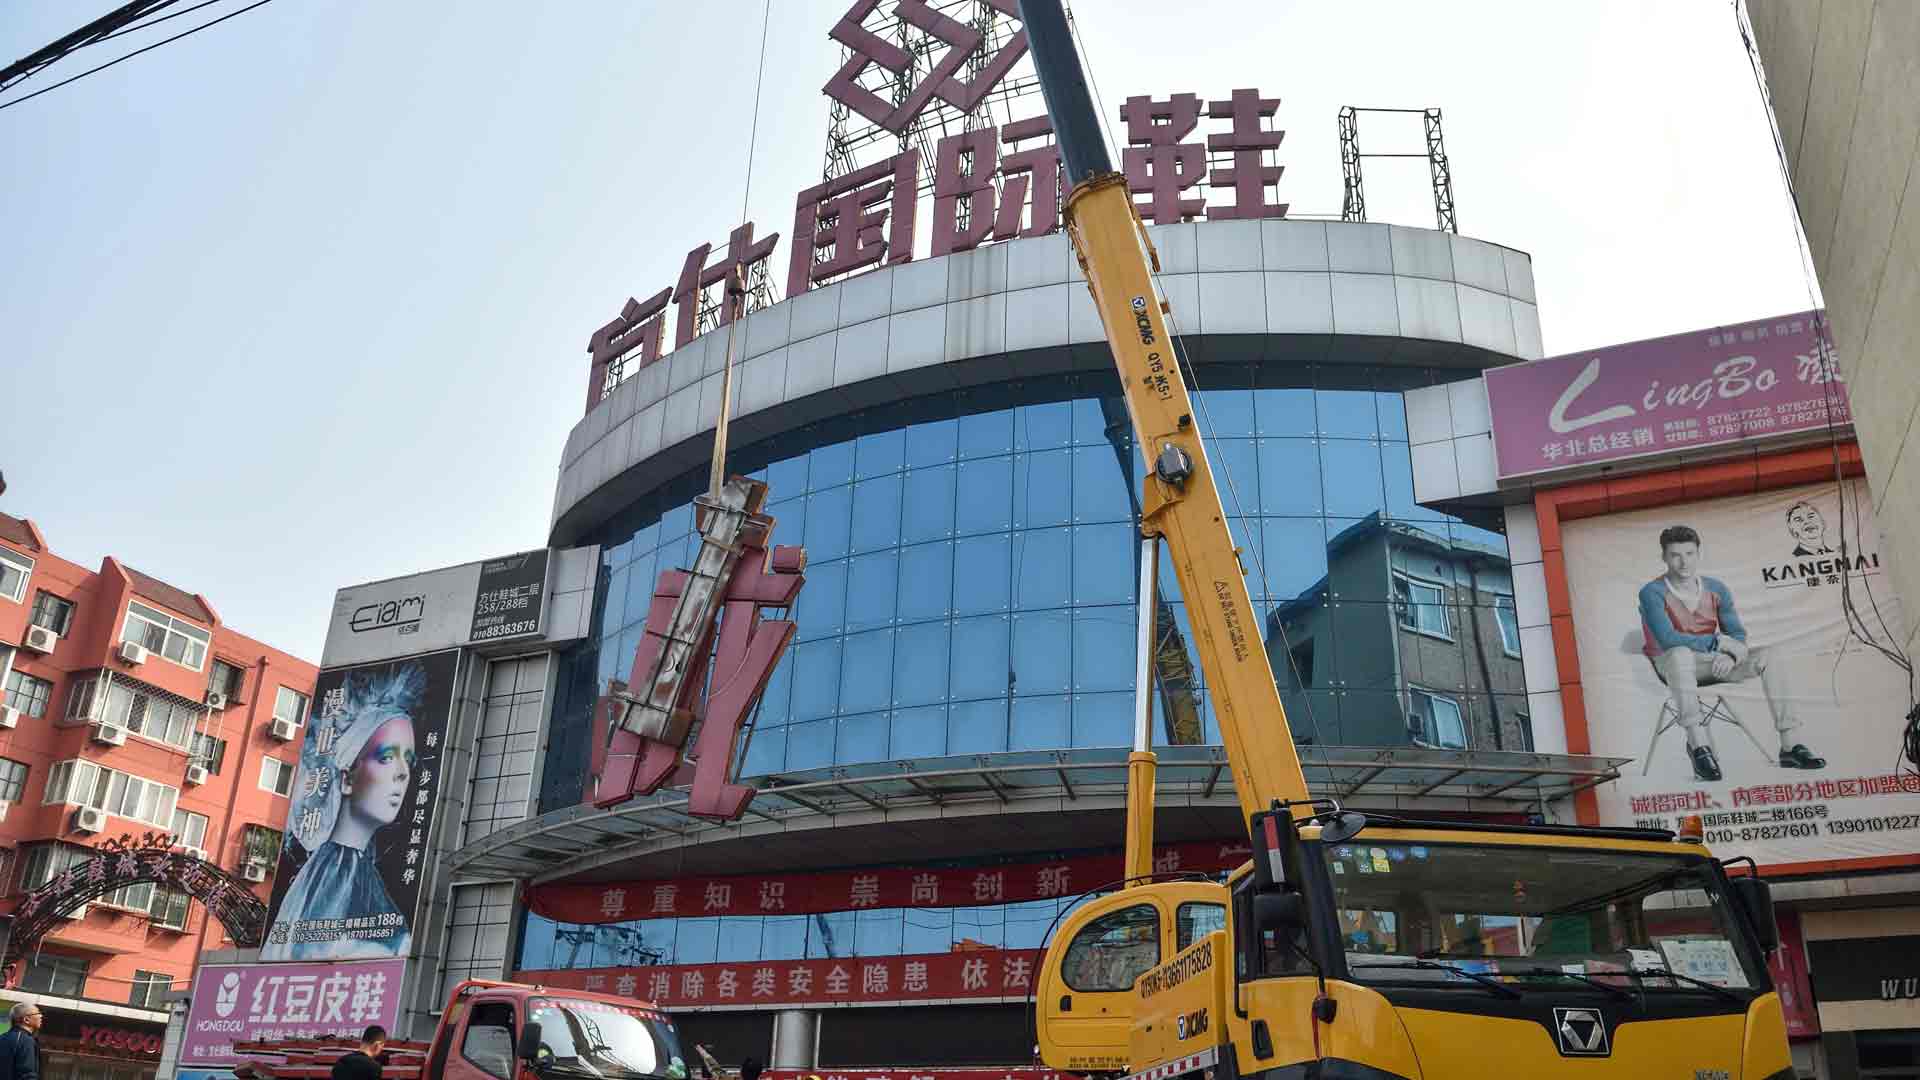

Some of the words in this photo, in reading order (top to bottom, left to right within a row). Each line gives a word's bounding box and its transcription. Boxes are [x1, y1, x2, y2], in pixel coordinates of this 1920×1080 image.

[1135, 308, 1155, 345] XCMG
[1549, 355, 1778, 433] LingBo
[1542, 427, 1655, 461] 华北总经销
[400, 731, 440, 886] 每一步都尽显奢华
[1706, 822, 1820, 844] 010-87827601
[600, 880, 786, 918] 尊重知识
[850, 865, 1073, 906] 崇尚创新
[248, 971, 387, 1024] 红豆皮鞋
[584, 961, 928, 1000] 严查消除各类安全隐患
[961, 957, 1032, 991] 依法
[196, 1019, 244, 1032] HONGDOU
[1185, 1008, 1208, 1039] XCMG
